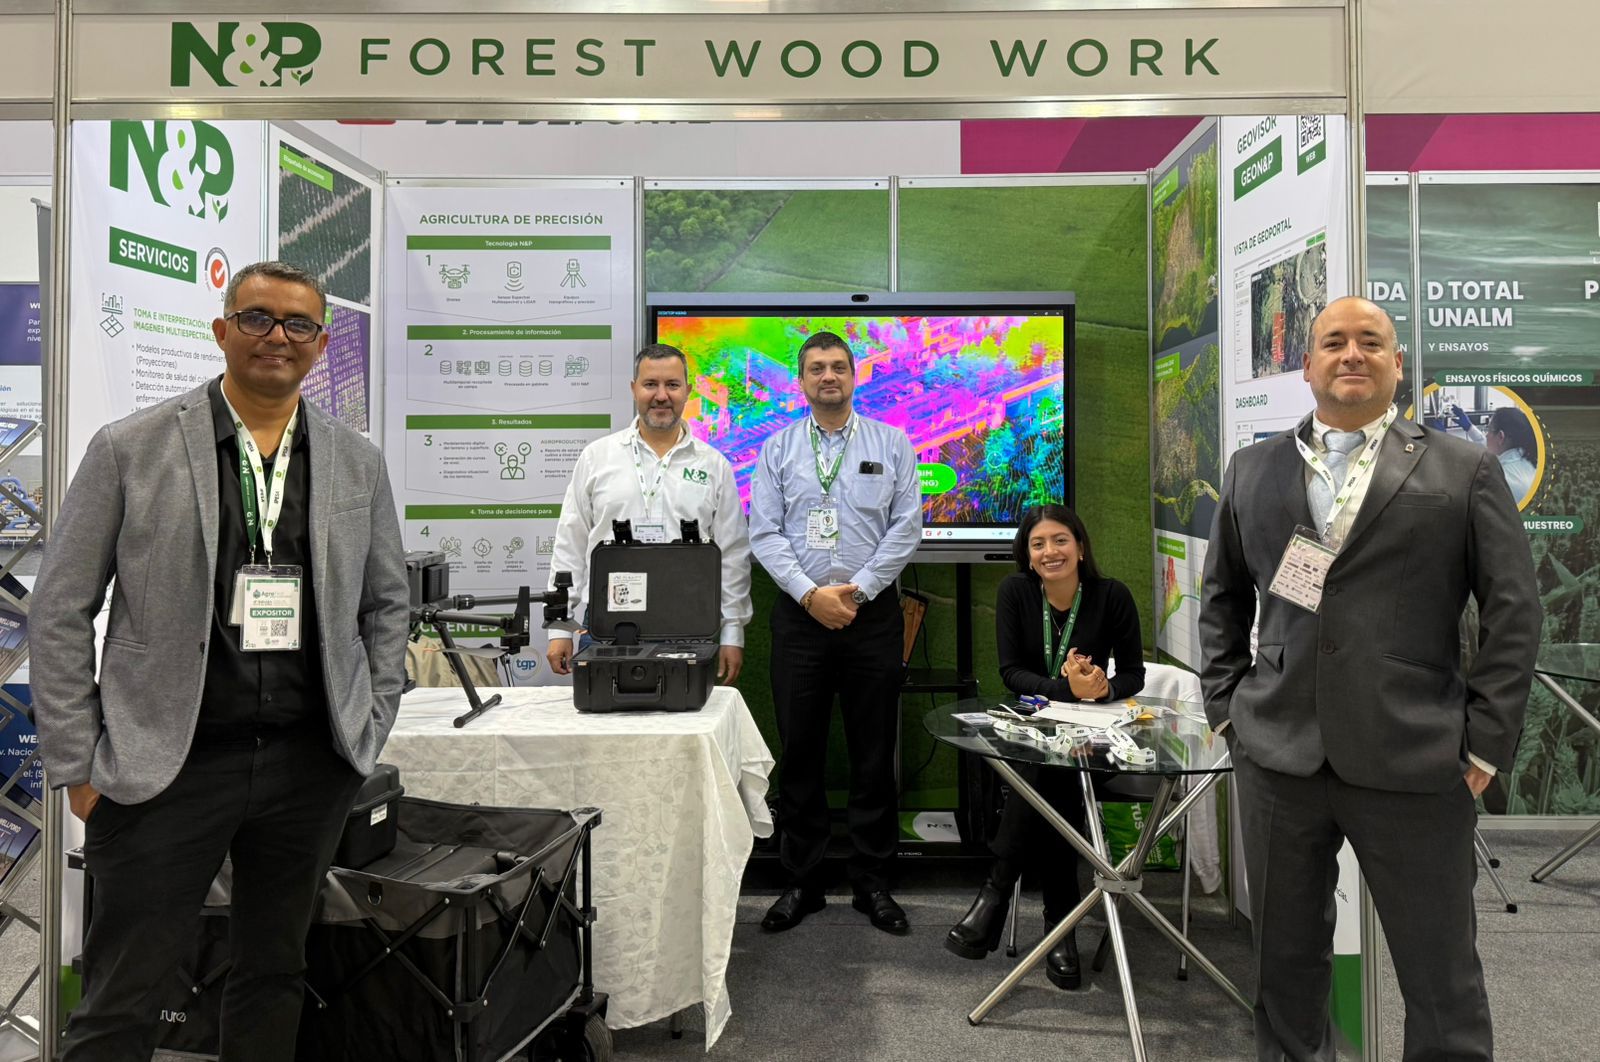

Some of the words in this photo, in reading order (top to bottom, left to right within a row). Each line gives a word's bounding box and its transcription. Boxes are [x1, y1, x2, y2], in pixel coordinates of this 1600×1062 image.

[170, 22, 322, 87] N&P
[360, 38, 656, 77] FOREST
[704, 39, 940, 78] WOOD
[989, 38, 1221, 77] WORK
[1241, 152, 1273, 187] GEON&P
[419, 214, 510, 225] AGRICULTURA
[514, 214, 531, 225] DE
[535, 211, 604, 225] PRECISIÓN
[1233, 240, 1248, 256] VISTA
[1257, 217, 1292, 244] GEOPORTAL
[484, 240, 518, 248] Tecnología
[119, 238, 189, 273] SERVICIOS
[425, 254, 432, 266] 1
[1447, 281, 1524, 300] TOTAL
[134, 308, 152, 320] TOMA
[153, 312, 158, 320] E
[1428, 307, 1513, 327] UNALM
[136, 343, 160, 355] Modelos
[161, 348, 192, 361] productivos
[193, 352, 200, 360] de
[424, 344, 434, 356] 2
[1428, 343, 1436, 352] Y
[1439, 342, 1489, 352] ENSAYOS
[136, 356, 178, 370] (Proyecciones)
[136, 368, 163, 381] Monitoreo
[166, 372, 173, 380] de
[174, 372, 188, 382] salud
[1445, 374, 1492, 383] ENSAYOS
[1493, 372, 1530, 383] FÍSICOS
[1532, 372, 1582, 384] QUÍMICOS
[1236, 394, 1268, 408] DASHBOARD
[424, 434, 433, 446] 3
[420, 525, 430, 538] 4
[516, 659, 536, 671] tgp
